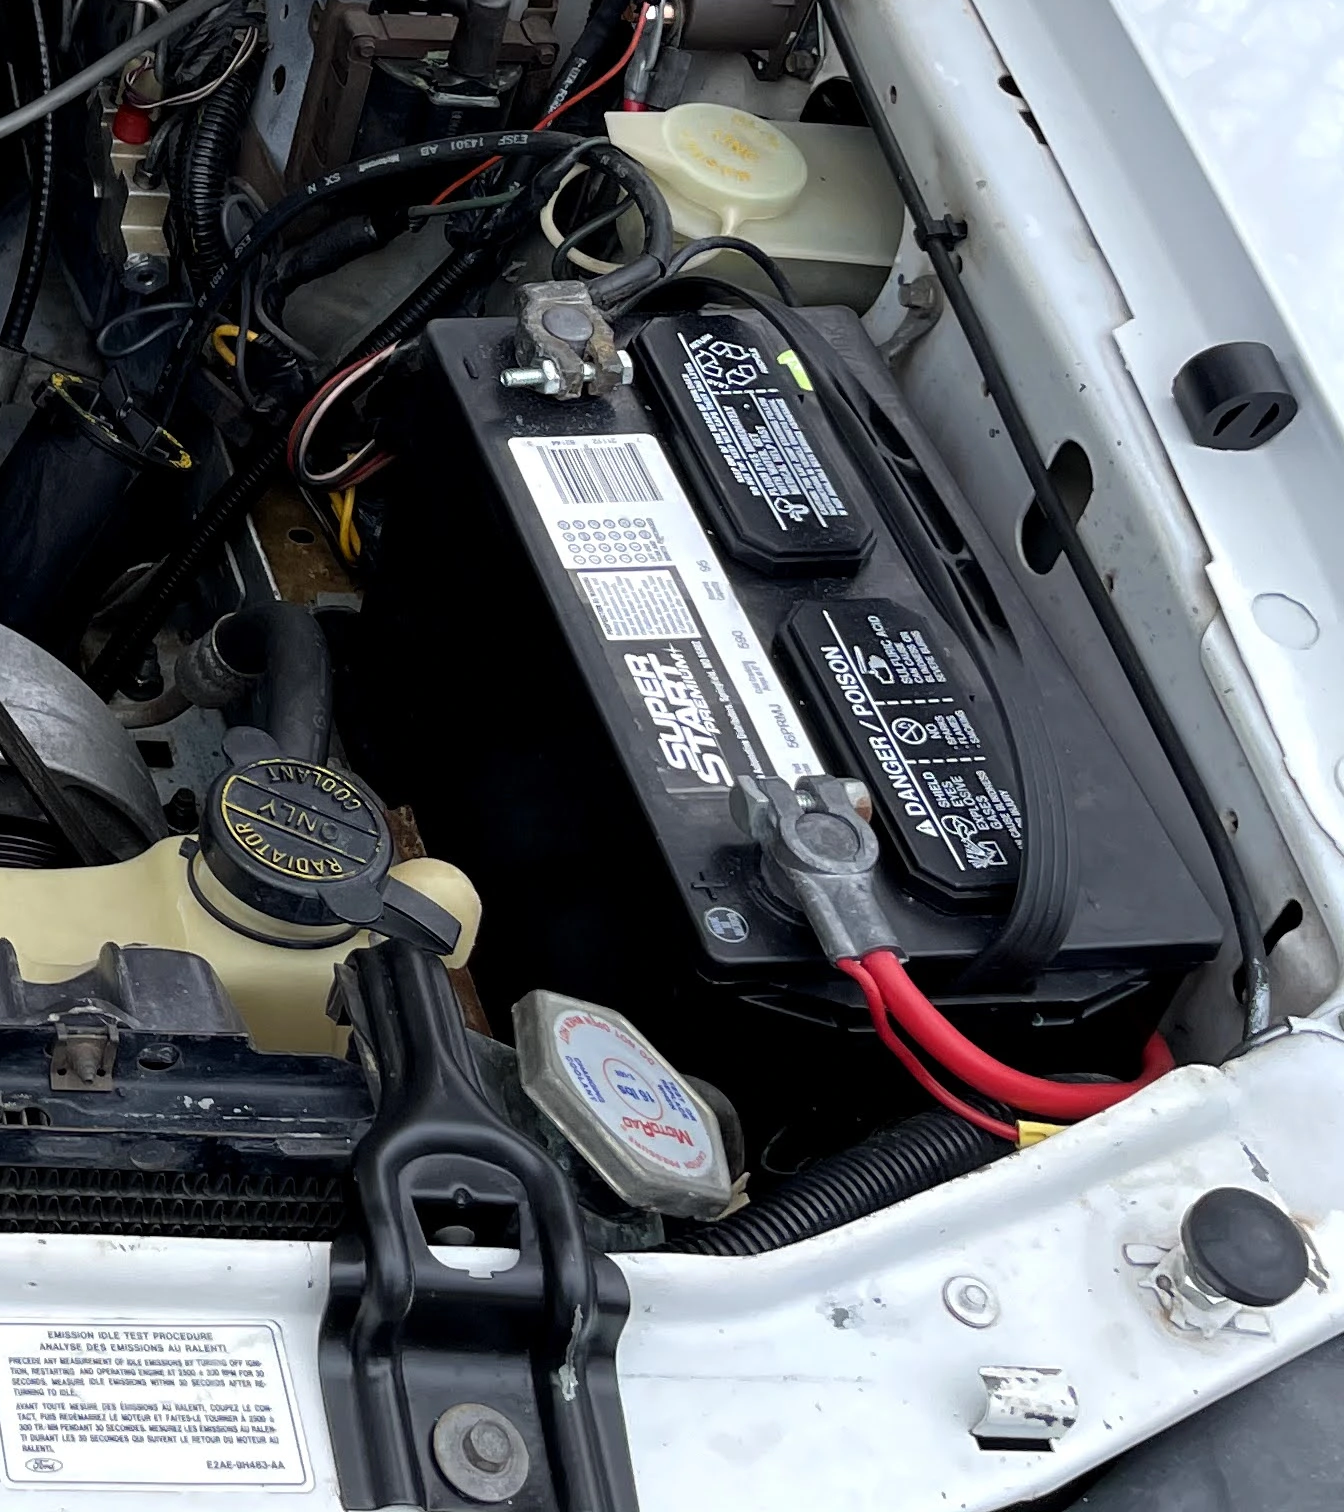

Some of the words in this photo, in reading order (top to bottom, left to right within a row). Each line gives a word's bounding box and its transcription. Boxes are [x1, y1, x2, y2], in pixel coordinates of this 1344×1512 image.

[868, 615, 888, 638] ACID
[880, 639, 913, 685] SULFURIC
[894, 641, 911, 664] CAUSE
[907, 643, 935, 683] BLINDNESS
[924, 656, 947, 683] SEVERE
[821, 646, 874, 717] POISON
[624, 653, 686, 769] SUPER
[647, 653, 734, 787] START
[925, 724, 942, 739] NO
[946, 715, 969, 745] FLAMES
[266, 766, 362, 812] COOLANT
[869, 736, 928, 817] DANGER
[923, 771, 950, 808] SHIELD
[941, 780, 963, 808] EYES
[259, 798, 339, 841] ONLY
[950, 775, 989, 831] EXPLOSIVE
[976, 795, 1004, 830] GASES
[235, 821, 342, 875] RADIATOR
[565, 1055, 597, 1103] COOLANT
[574, 1057, 605, 1103] CHANGING
[40, 1342, 82, 1351] ANALYSE
[86, 1343, 107, 1351] DES
[110, 1343, 164, 1352] EMISSIONS
[168, 1344, 181, 1353] AU
[47, 1331, 94, 1339] EMISSION
[124, 1331, 148, 1340] TEST
[153, 1332, 213, 1340] PROCEDURE
